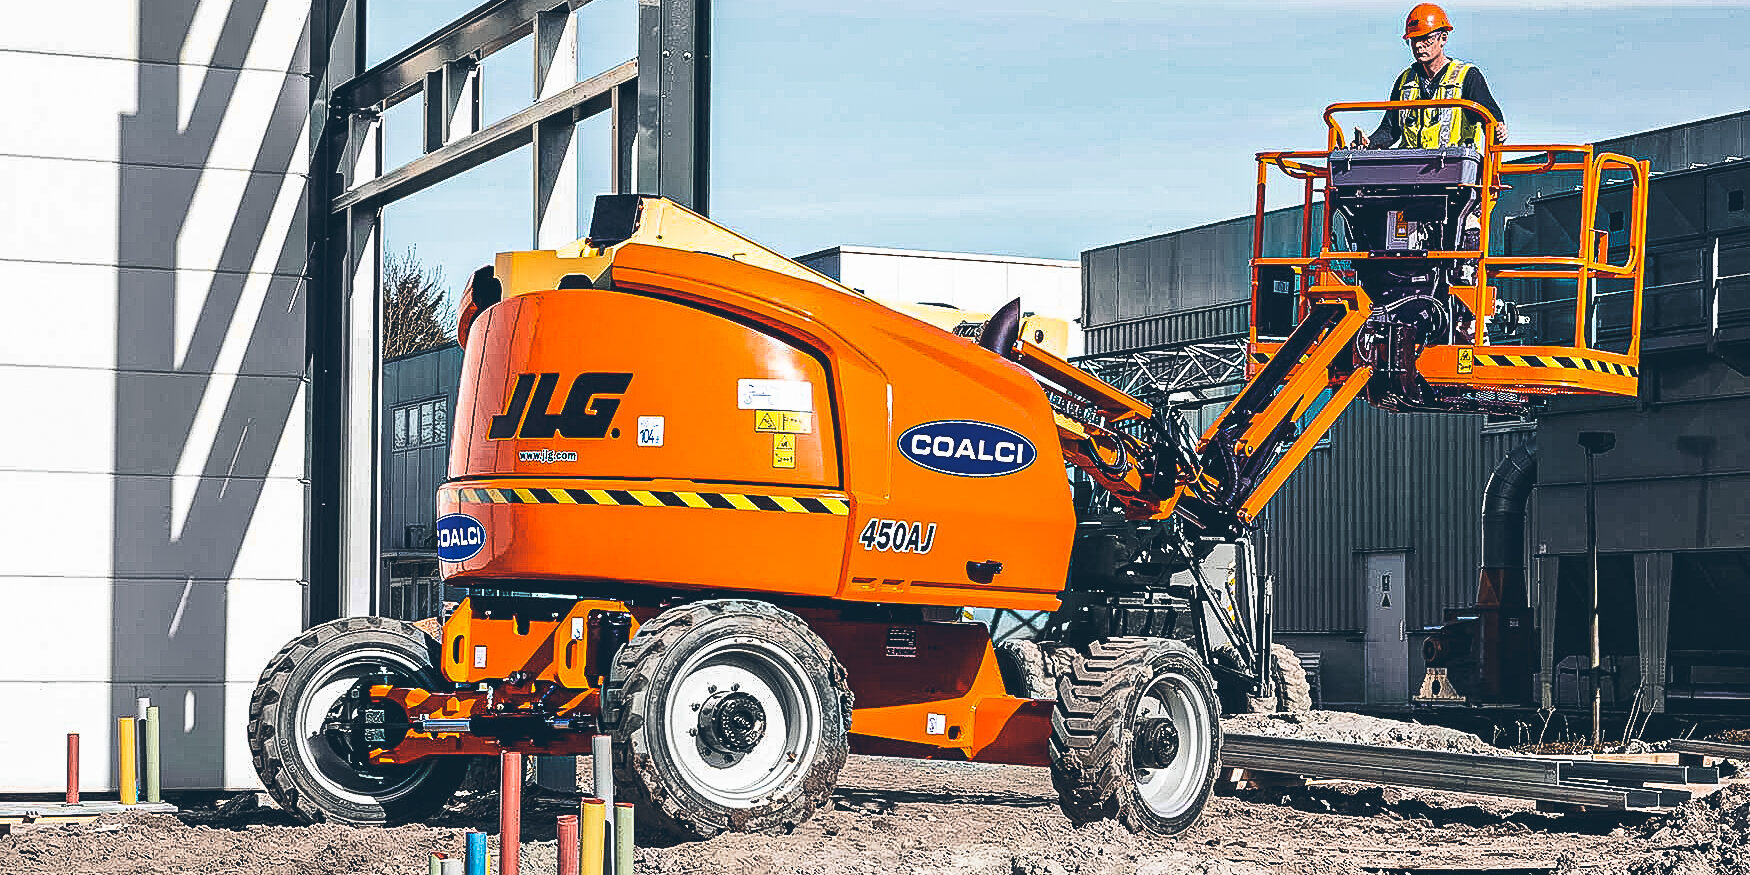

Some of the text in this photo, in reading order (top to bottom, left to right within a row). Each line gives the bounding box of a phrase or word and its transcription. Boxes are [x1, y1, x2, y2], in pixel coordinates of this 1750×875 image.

[639, 428, 655, 444] 104
[519, 449, 577, 463] www.jlg.com
[911, 434, 1024, 464] COALCI
[859, 518, 937, 554] 450AJ
